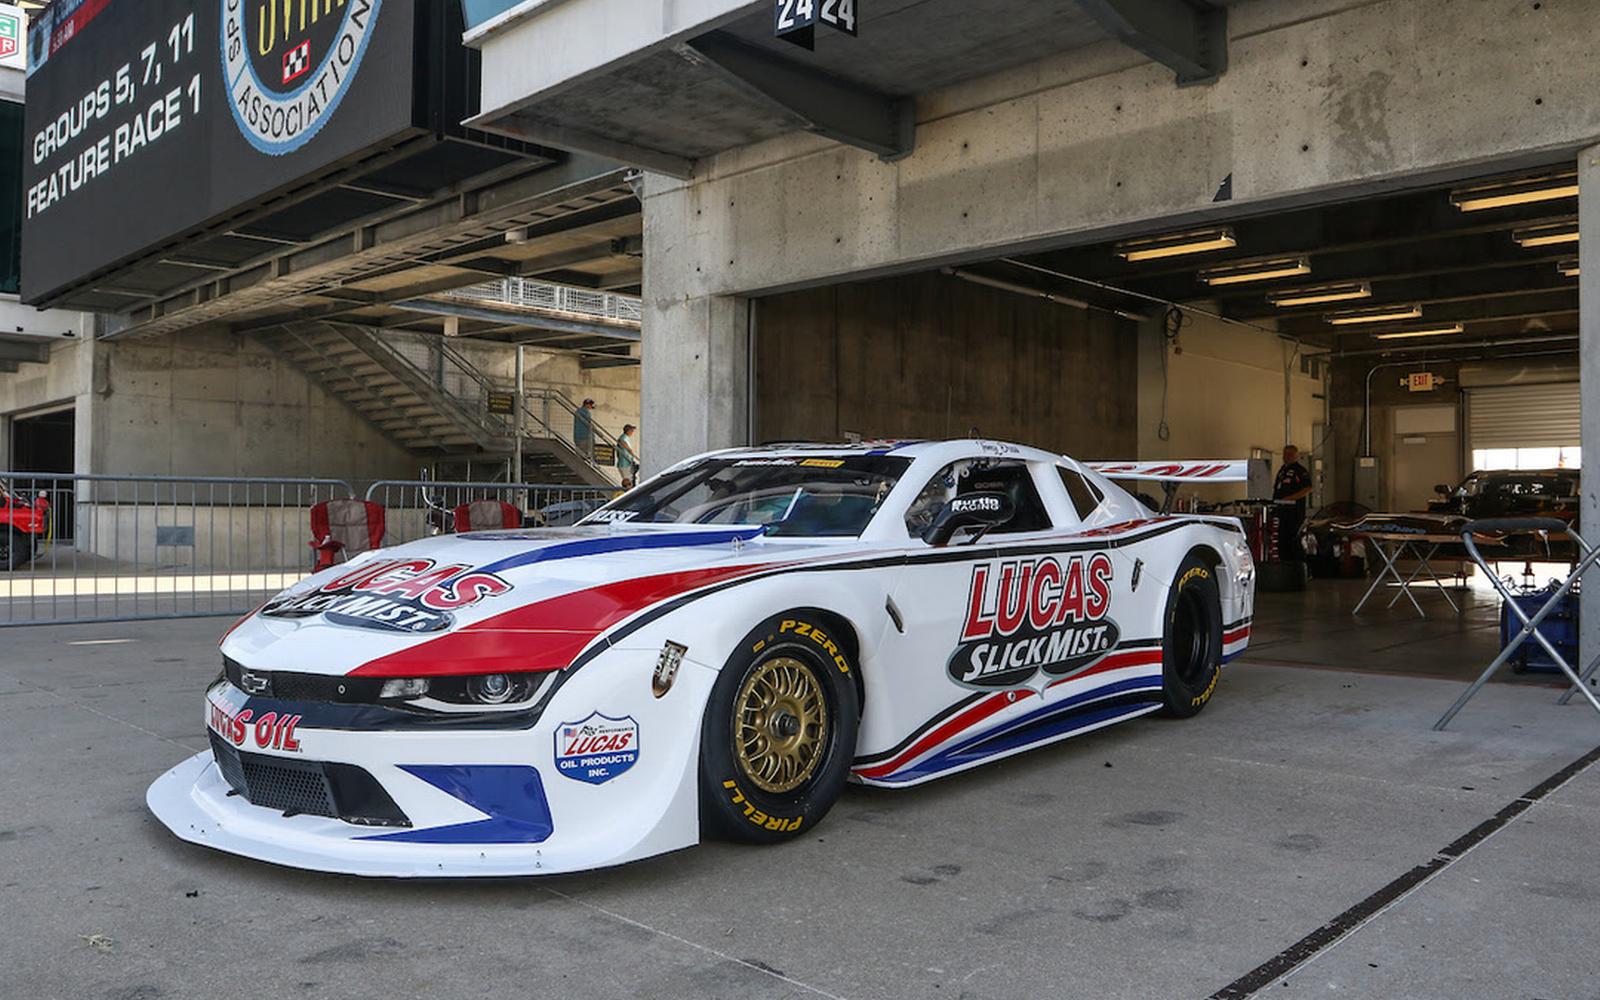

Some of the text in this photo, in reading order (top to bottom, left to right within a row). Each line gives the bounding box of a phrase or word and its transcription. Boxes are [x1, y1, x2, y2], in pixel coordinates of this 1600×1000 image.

[778, 0, 814, 30] 24
[820, 0, 854, 31] 24
[238, 0, 371, 138] ASSOCIATION
[33, 12, 194, 165] GROUPS 5, 7, 11
[27, 73, 200, 219] FEATURE RACE 1
[1413, 374, 1428, 386] EXIT
[951, 504, 1000, 512] RACING
[312, 557, 515, 611] UCAS
[959, 552, 1113, 644] LUCAS
[255, 711, 302, 752] OIL
[564, 733, 633, 756] LUCAS
[560, 754, 634, 769] OIL PRODUCTS
[588, 768, 609, 777] INC.
[722, 779, 804, 832] PIRELLI
